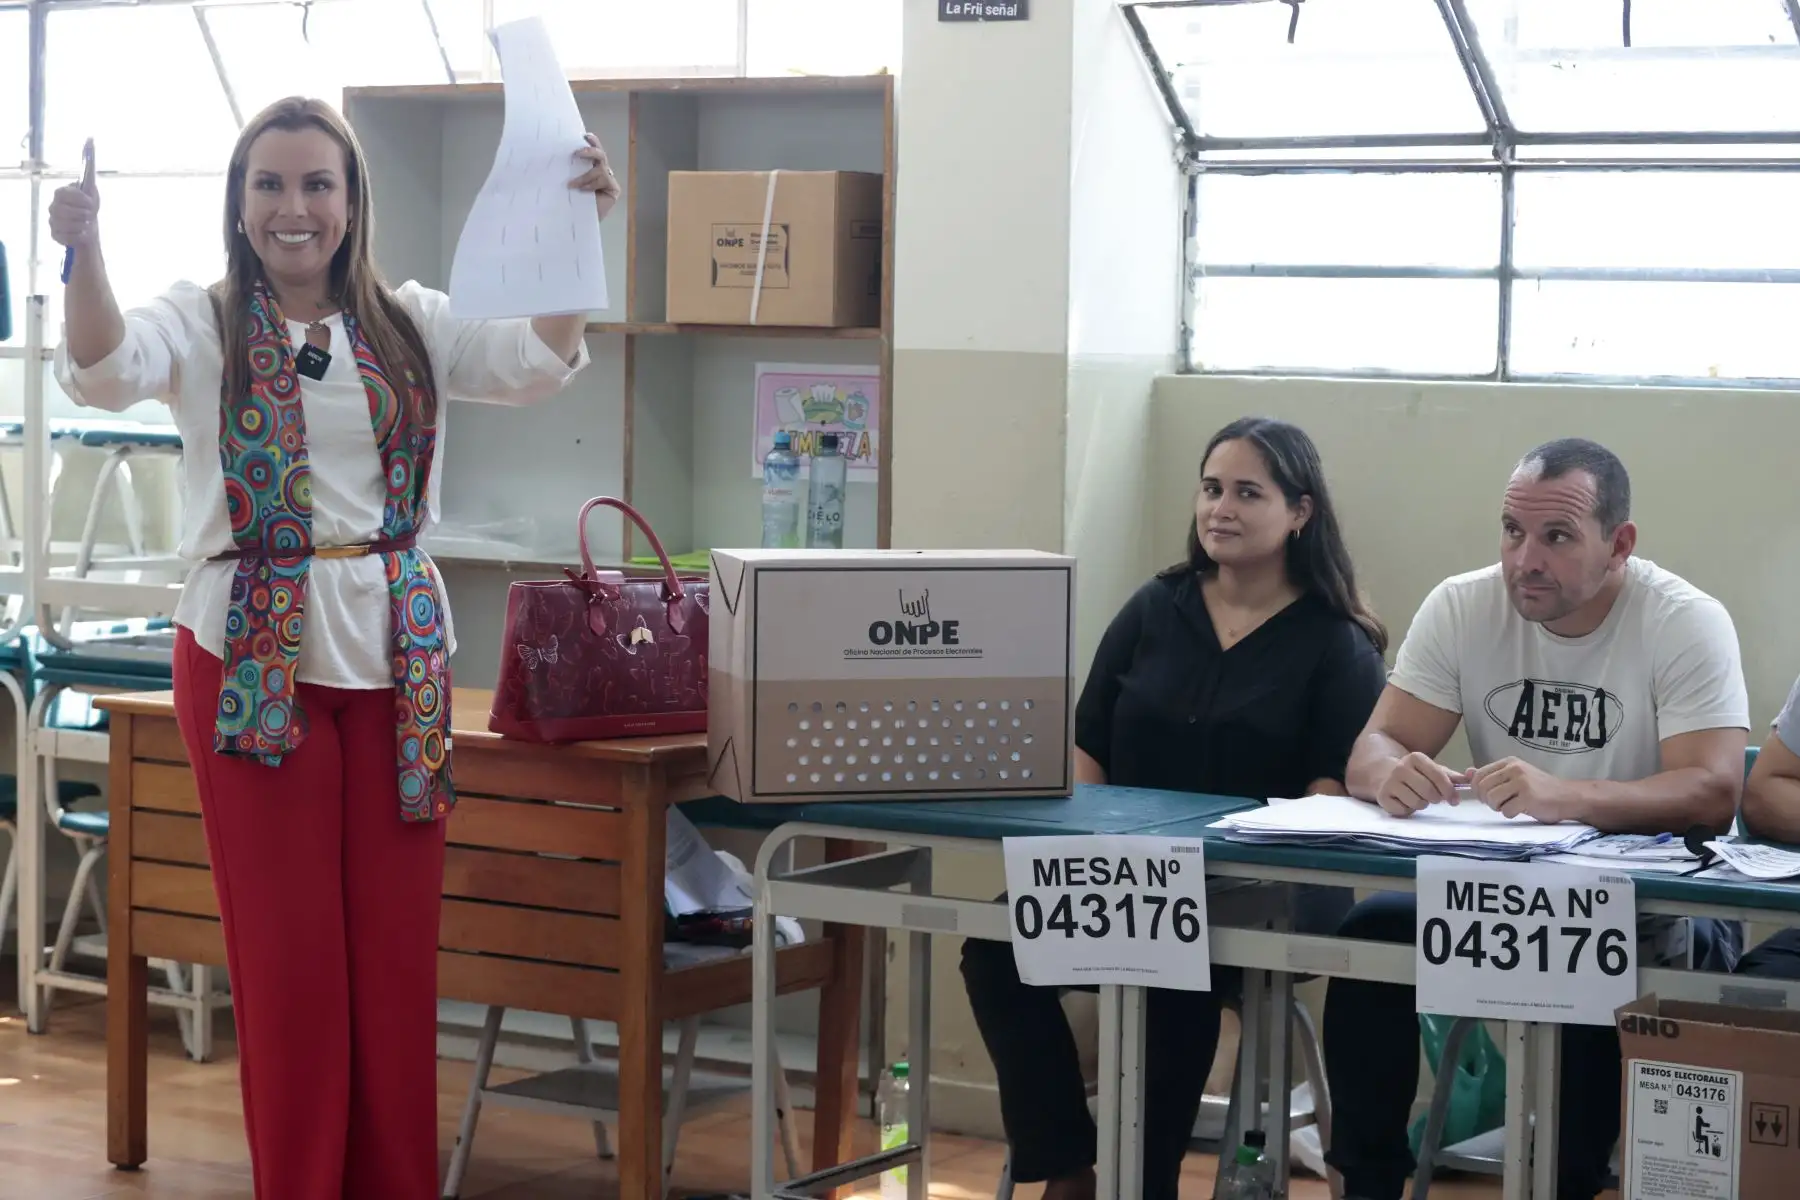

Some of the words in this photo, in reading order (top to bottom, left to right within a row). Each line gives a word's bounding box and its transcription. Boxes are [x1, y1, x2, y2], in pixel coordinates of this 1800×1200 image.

[946, 2, 961, 15] La
[985, 3, 1018, 16] señal
[716, 238, 745, 248] ONPE
[868, 620, 960, 646] ONPE
[870, 647, 901, 656] Nacional
[902, 647, 912, 656] de
[913, 647, 945, 656] Procesos
[1508, 678, 1607, 749] AERO
[1033, 857, 1138, 887] MESA
[1146, 858, 1181, 888] Nº
[1446, 880, 1556, 918] MESA
[1568, 888, 1610, 919] Nº
[1015, 893, 1201, 943] 043176
[1422, 917, 1629, 977] 043176
[1640, 1067, 1672, 1078] RESTOS
[1674, 1071, 1729, 1085] ELECTORALES
[1639, 1081, 1660, 1091] MESA
[1676, 1084, 1726, 1102] 043176
